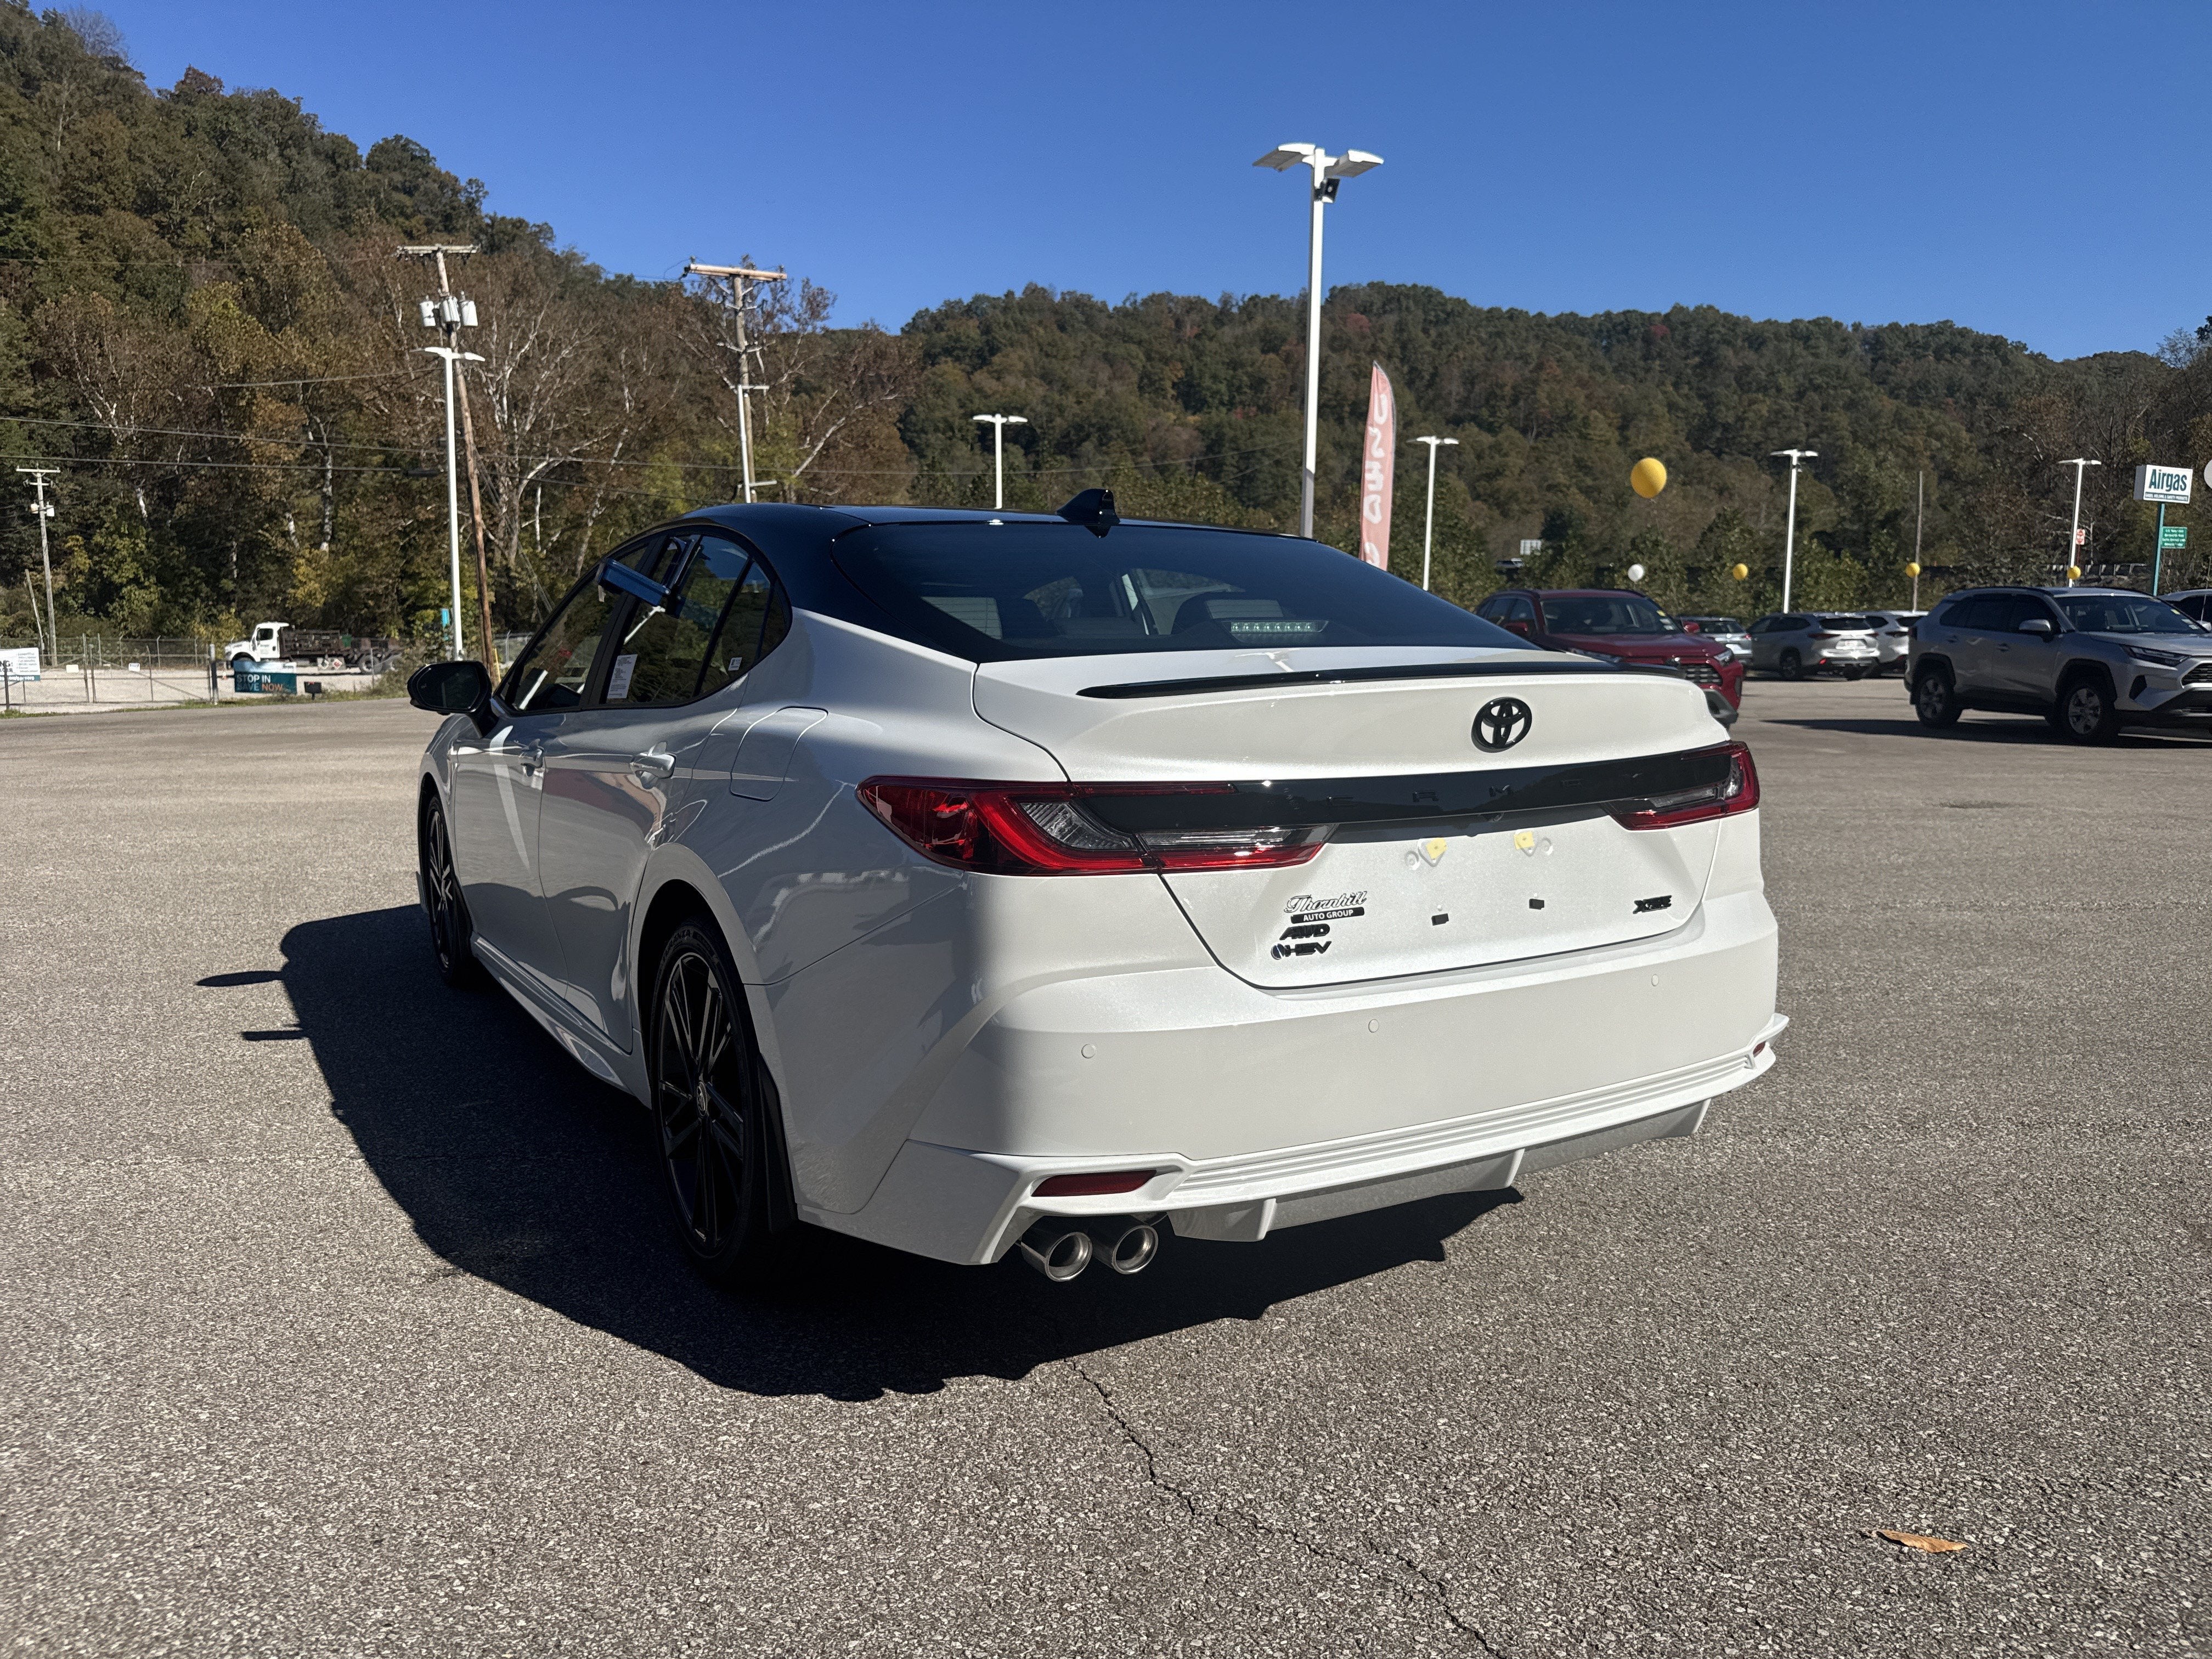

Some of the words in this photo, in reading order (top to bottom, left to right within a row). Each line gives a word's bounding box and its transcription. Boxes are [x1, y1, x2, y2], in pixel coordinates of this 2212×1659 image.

[2149, 469, 2187, 492] Airgas
[236, 674, 260, 683] STOP
[262, 674, 271, 684] IN
[262, 682, 283, 691] NOW
[1283, 890, 1368, 913] Thornhill
[1303, 912, 1325, 922] AUTO
[1326, 909, 1354, 919] GROUP
[1279, 923, 1330, 941] AWD
